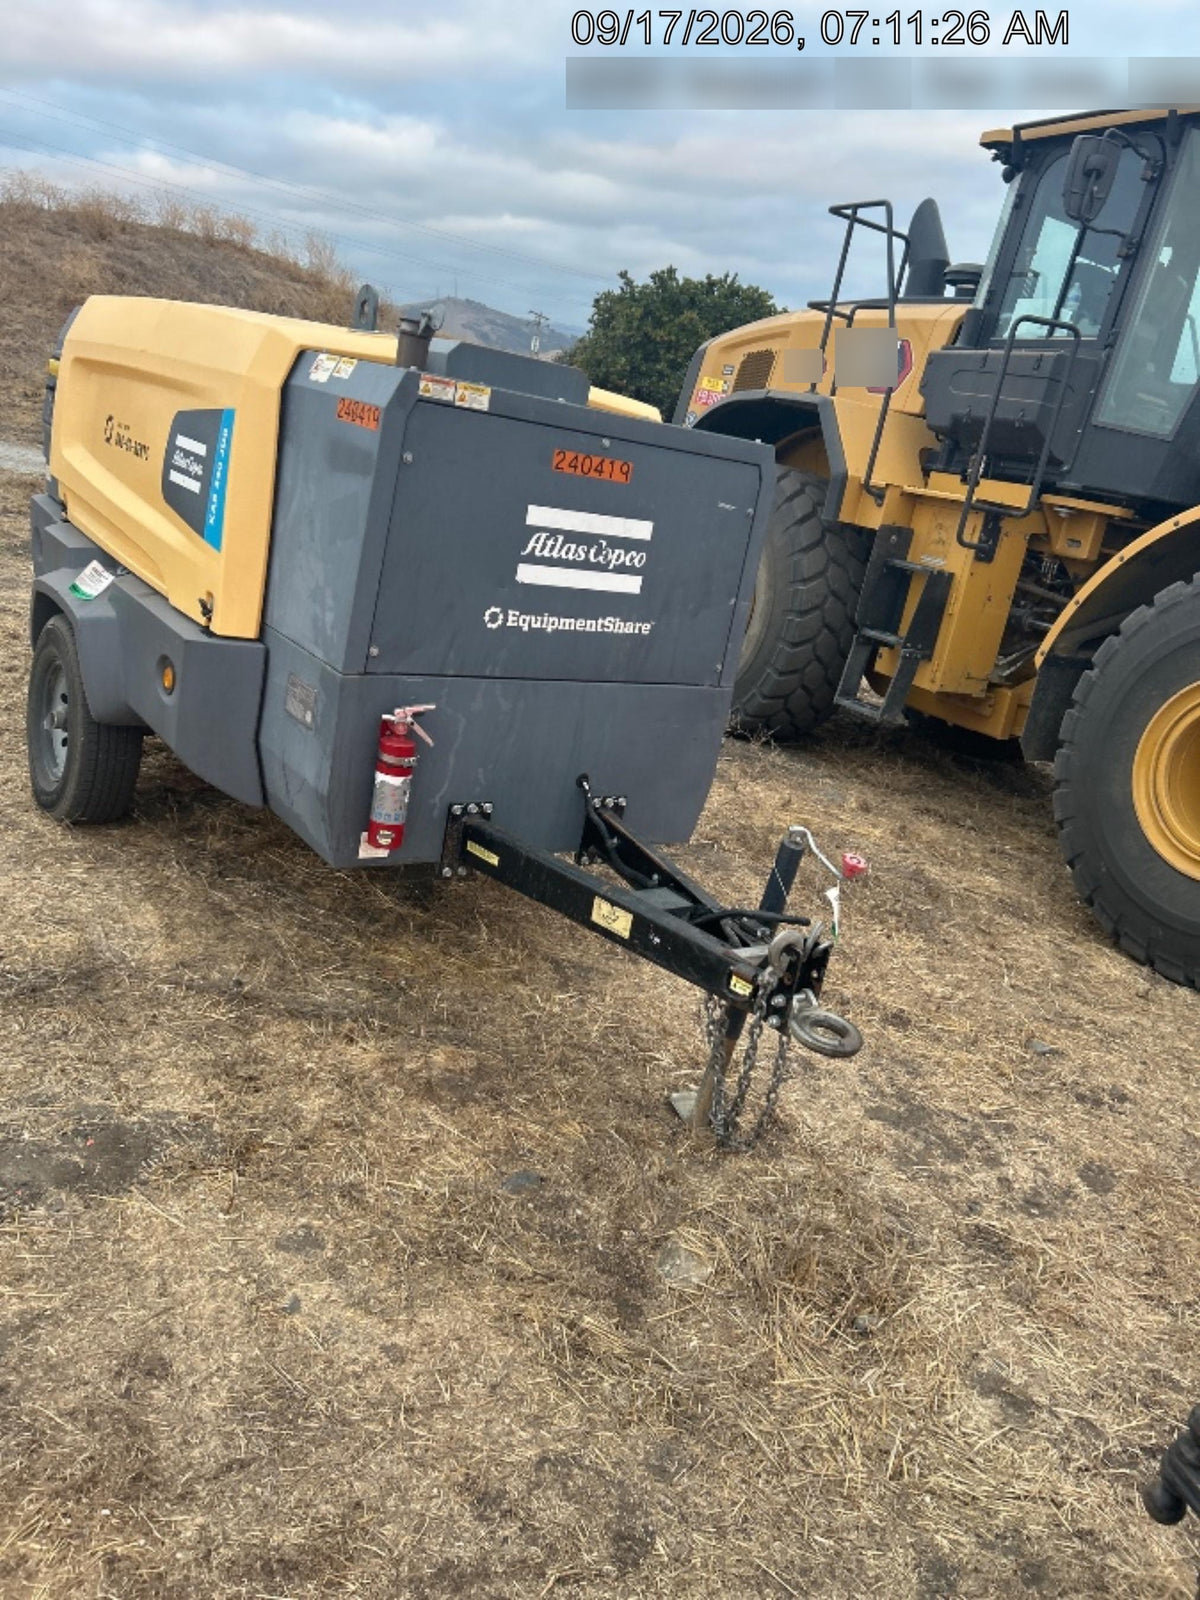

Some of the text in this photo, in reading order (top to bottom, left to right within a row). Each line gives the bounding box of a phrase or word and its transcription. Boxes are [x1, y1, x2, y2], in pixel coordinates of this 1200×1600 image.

[337, 397, 381, 426] 240419
[554, 450, 631, 482] 240419
[521, 532, 646, 569] Atlas Copco
[506, 609, 652, 635] EquipmentShare
